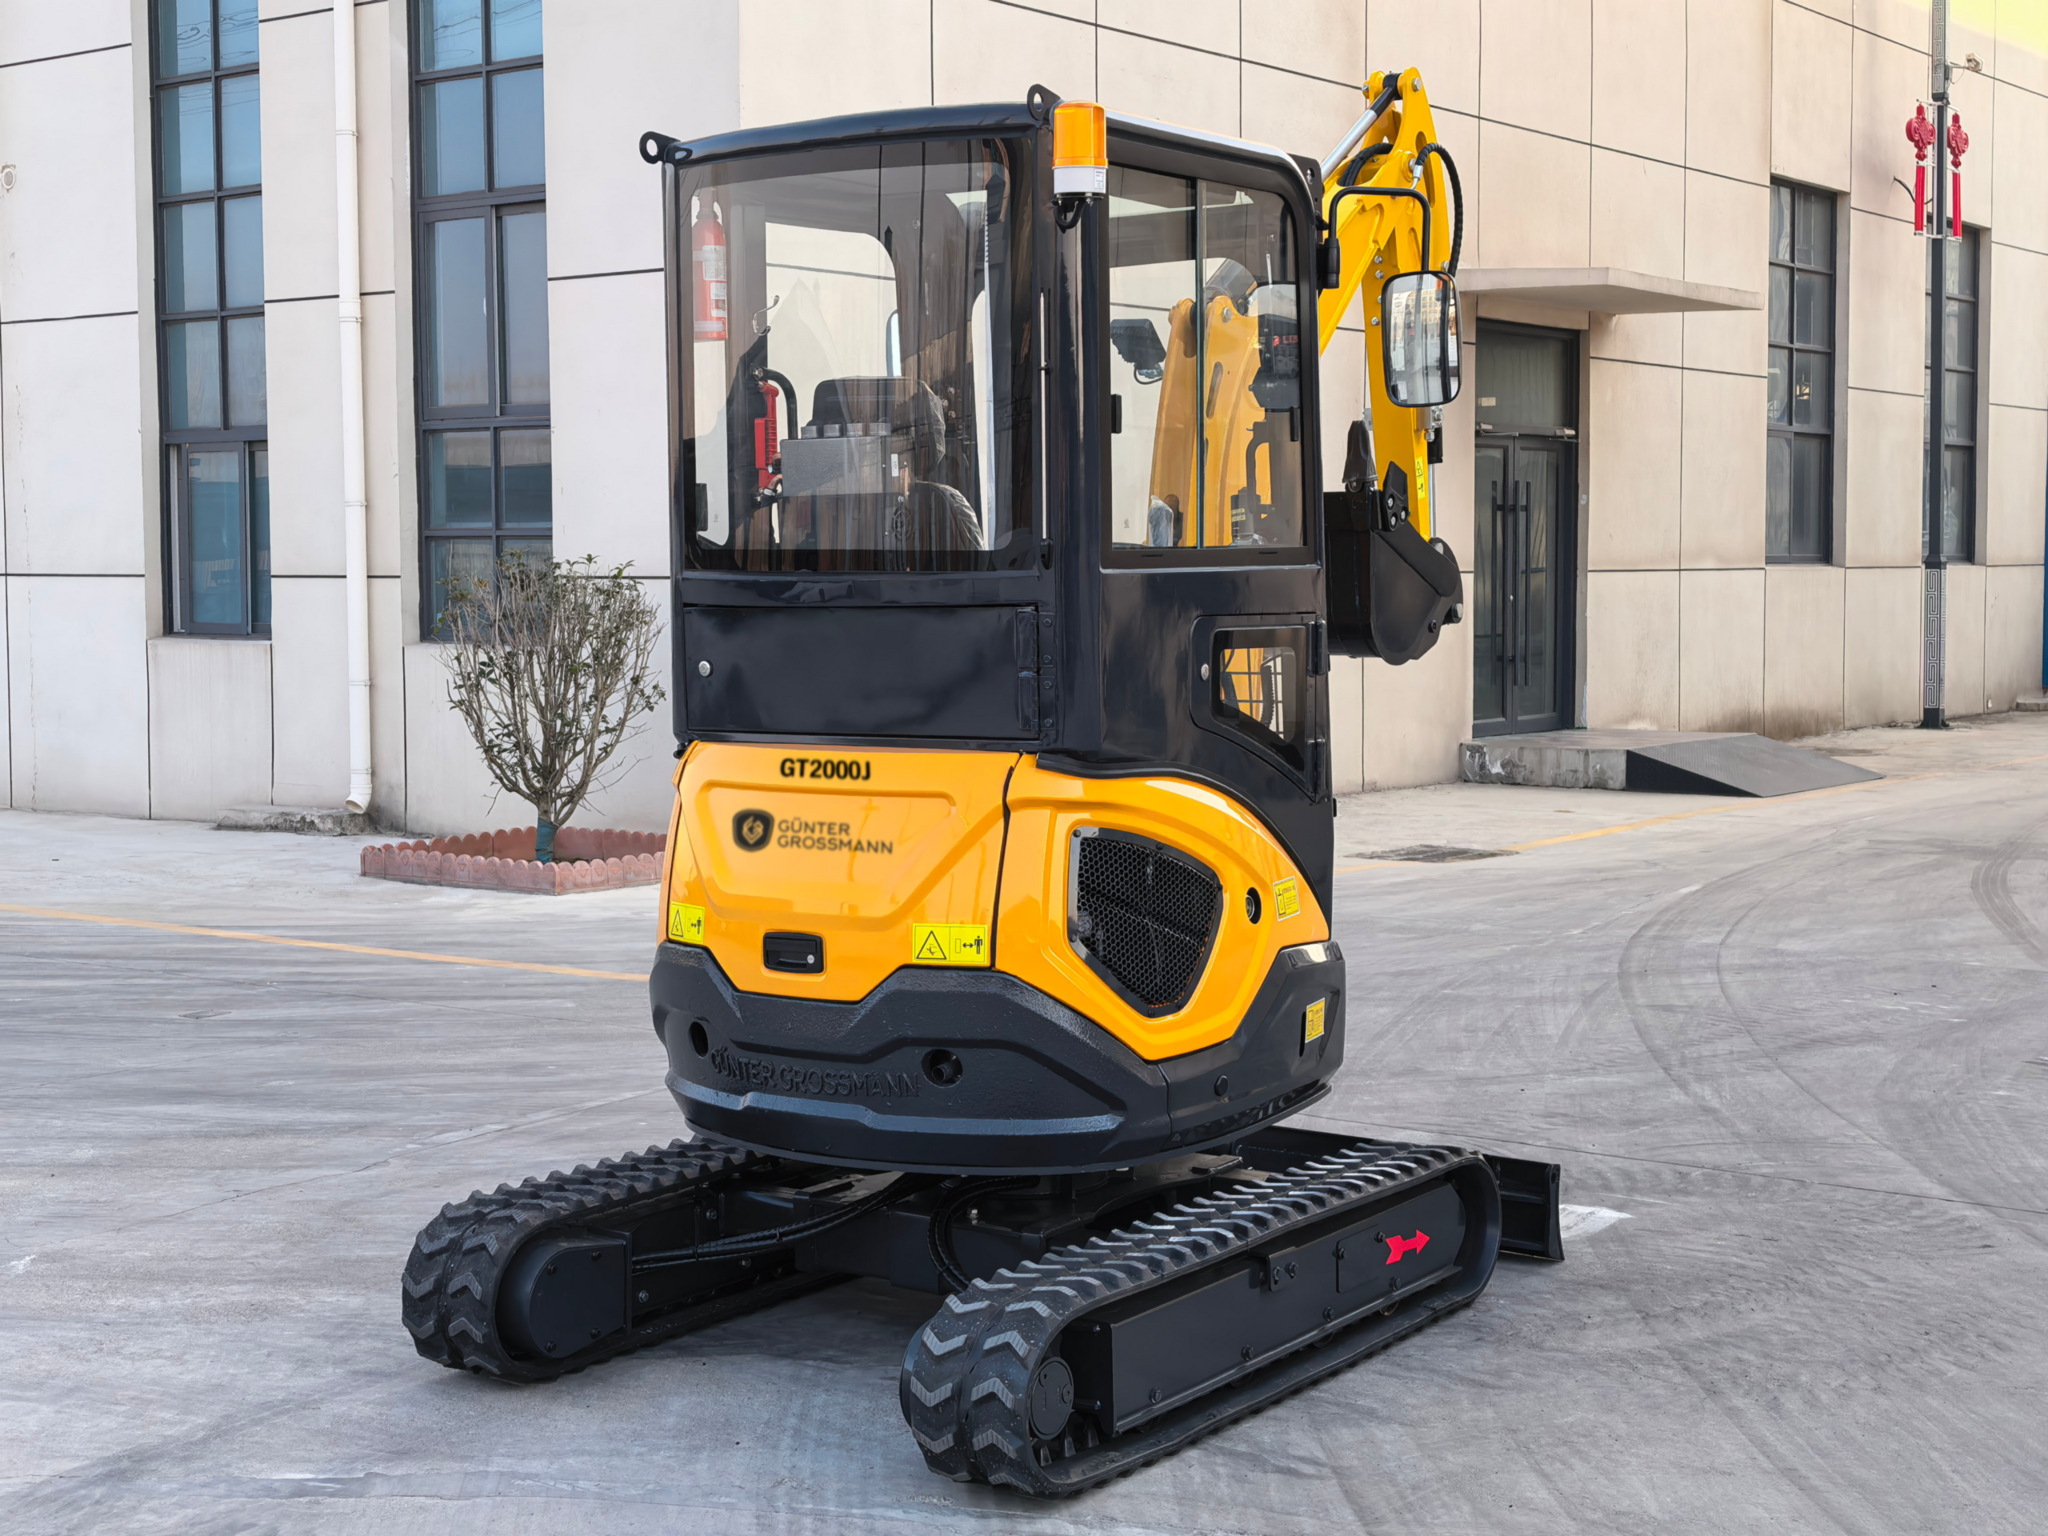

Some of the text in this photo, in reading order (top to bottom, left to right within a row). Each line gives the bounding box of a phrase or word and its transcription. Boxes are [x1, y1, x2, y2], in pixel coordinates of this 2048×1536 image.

[780, 758, 871, 780] GT2000J
[777, 817, 851, 836] GÜNTER
[777, 835, 893, 855] GROSSMANN
[711, 1045, 920, 1097] GÜNTER GROSSMANN
